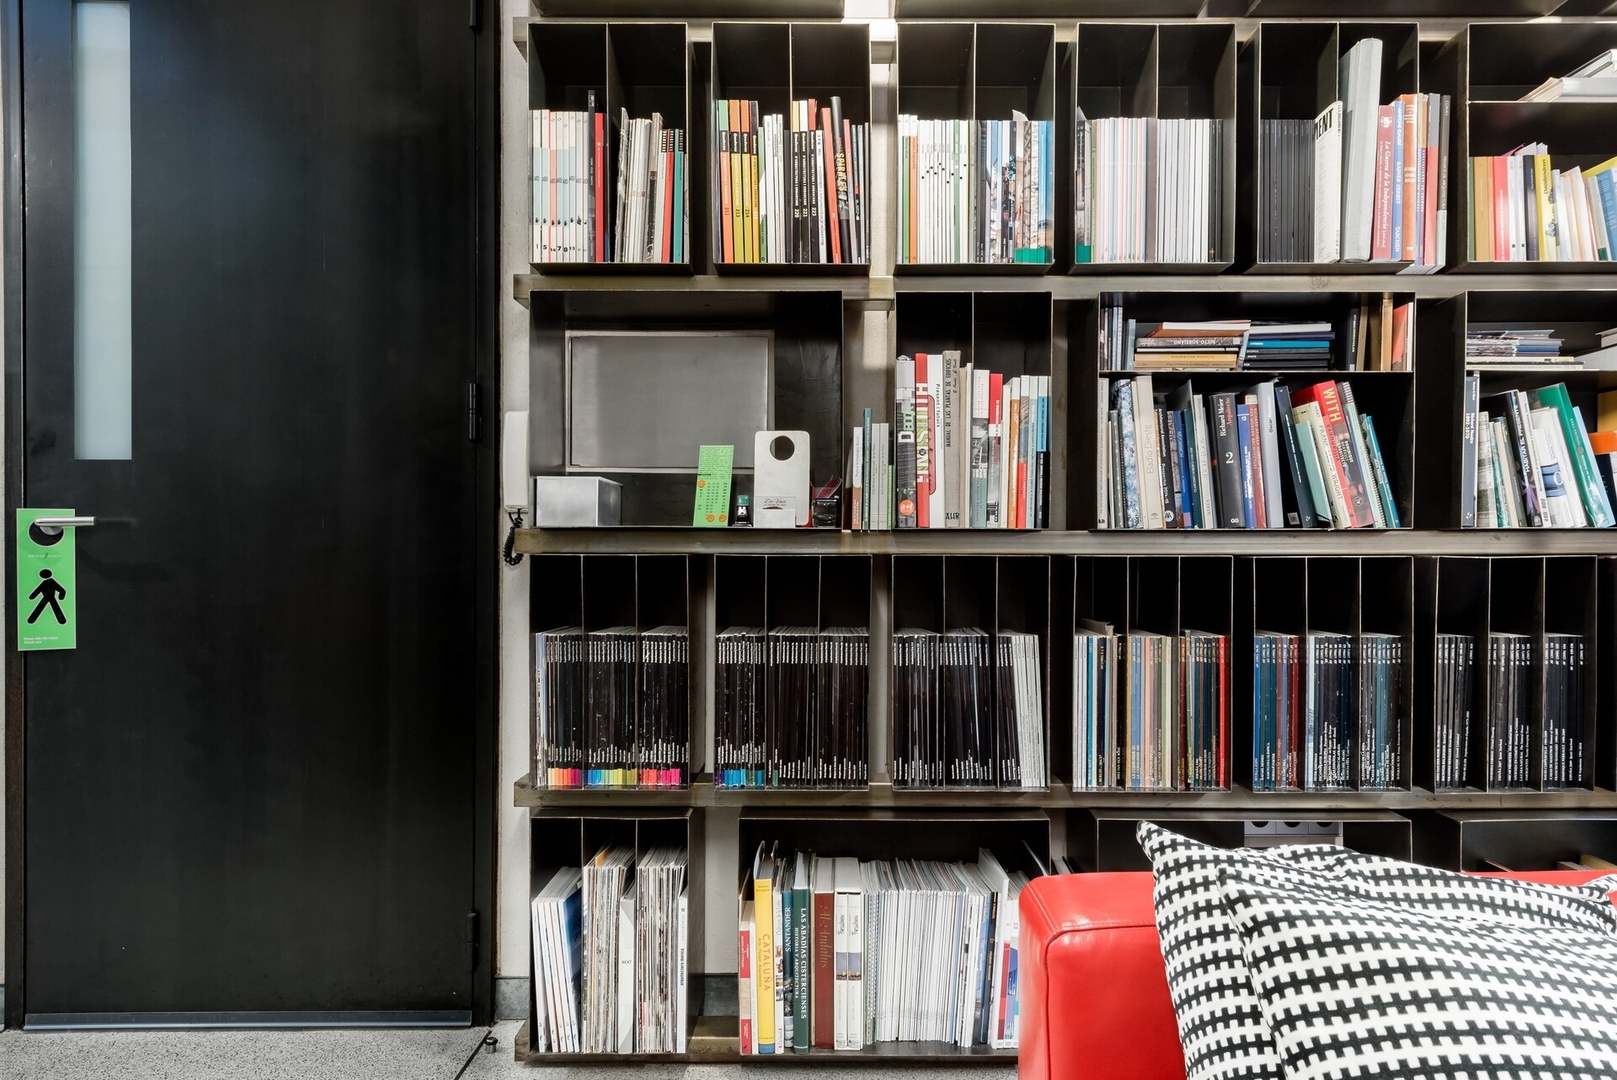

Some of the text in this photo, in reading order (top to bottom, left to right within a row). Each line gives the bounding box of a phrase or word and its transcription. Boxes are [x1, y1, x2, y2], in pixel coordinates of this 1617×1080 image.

[1323, 387, 1342, 422] WITH
[1514, 404, 1523, 436] PRESENTE
[1146, 451, 1154, 474] Eladio
[1226, 453, 1234, 464] 2
[1318, 425, 1329, 446] FRANK
[1331, 473, 1342, 500] WRIGHT
[1522, 446, 1530, 472] HABITAR
[820, 905, 831, 968] Al-Andalus
[763, 934, 771, 991] CATALUÑA
